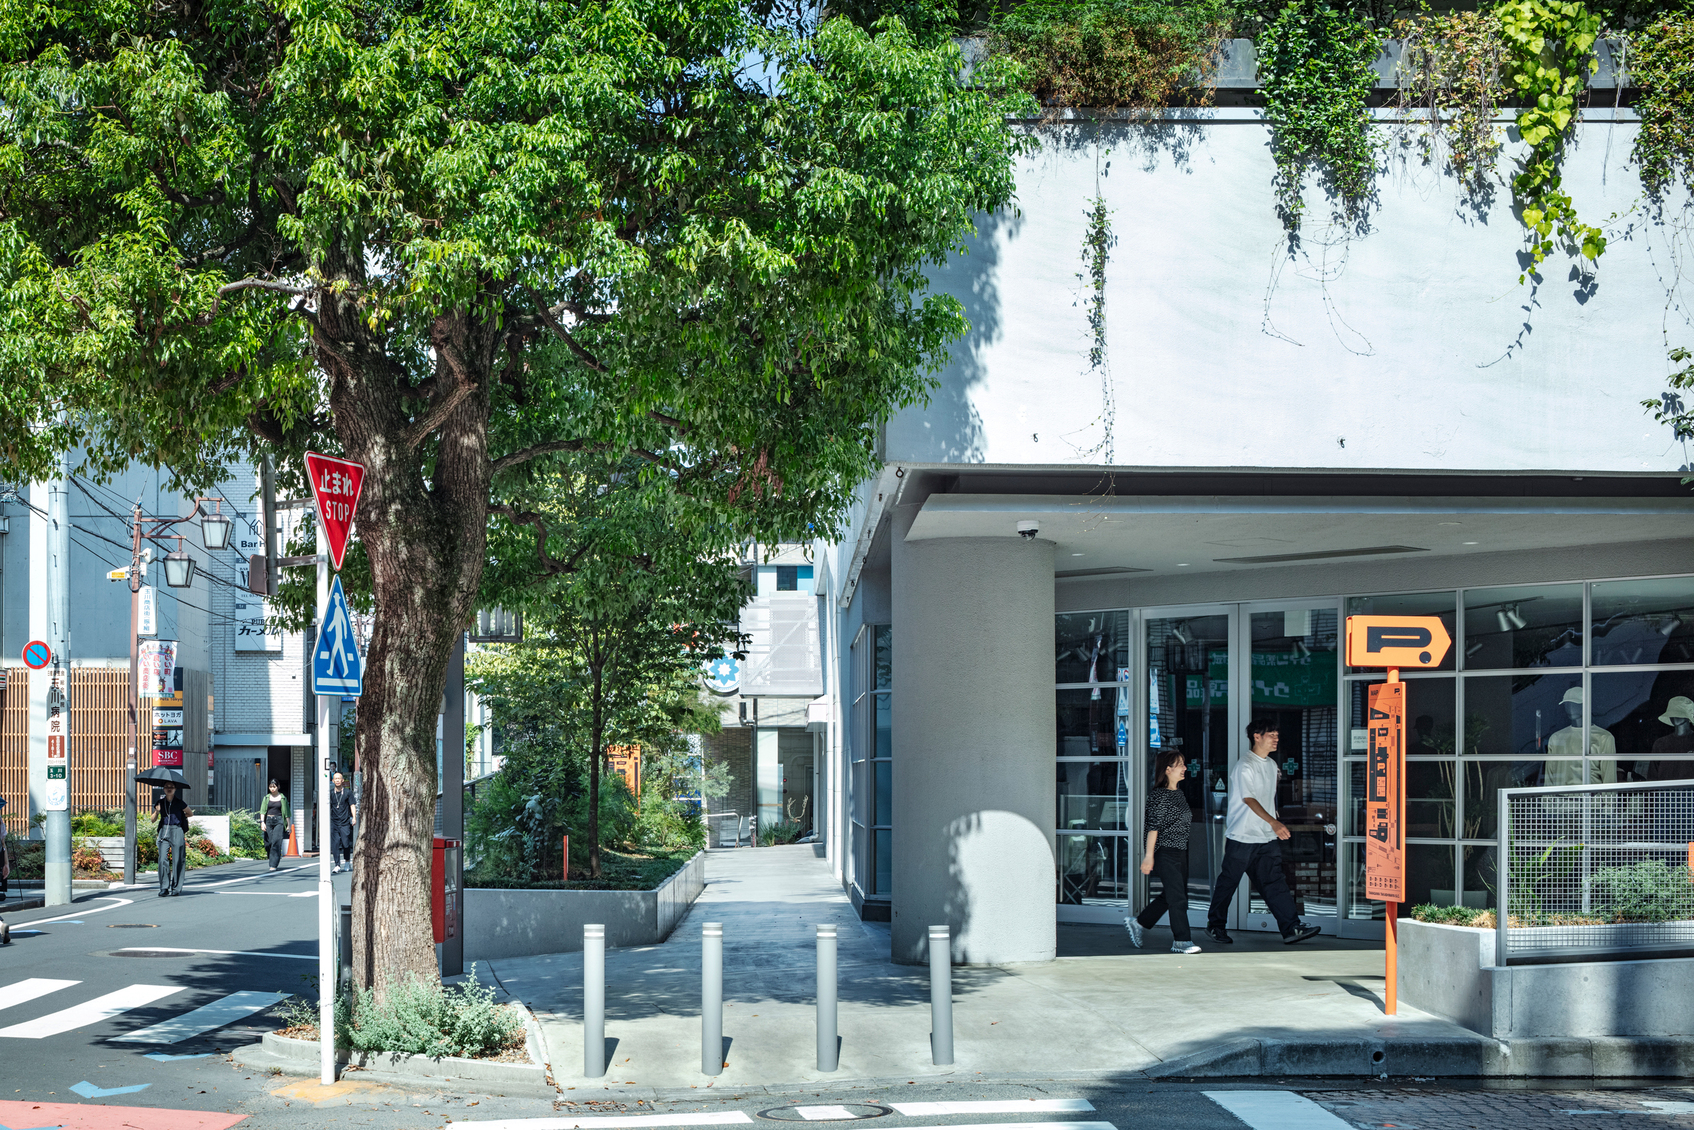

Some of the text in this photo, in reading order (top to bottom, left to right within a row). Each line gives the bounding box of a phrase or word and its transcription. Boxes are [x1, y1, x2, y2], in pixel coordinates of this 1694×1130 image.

[319, 468, 354, 497] 止まれ
[325, 500, 350, 523] STOP
[241, 540, 258, 548] Bar
[251, 618, 265, 626] PUB
[164, 654, 172, 676] いい町
[51, 678, 60, 733] 玉川病院
[157, 750, 178, 760] SBC
